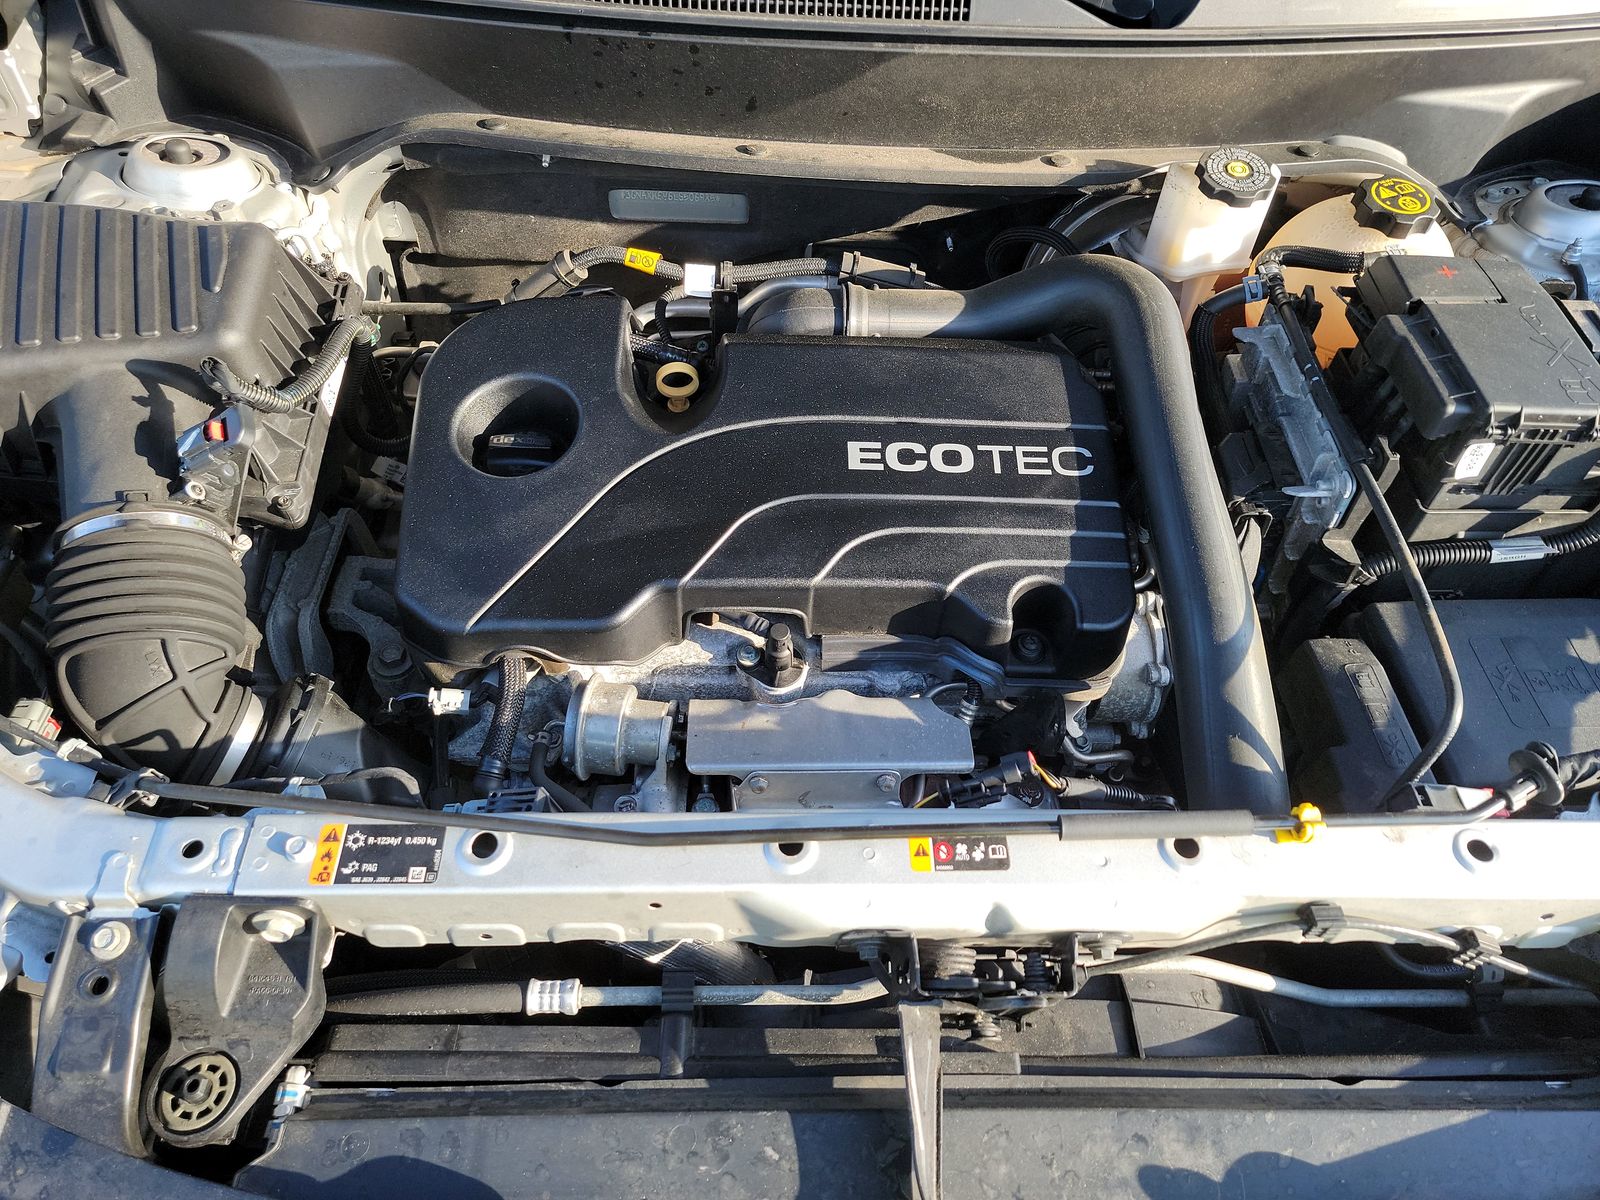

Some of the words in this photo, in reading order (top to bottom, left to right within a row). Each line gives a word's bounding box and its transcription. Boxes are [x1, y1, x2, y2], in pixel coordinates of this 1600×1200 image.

[847, 441, 1094, 477] ECOTEC
[367, 836, 402, 847] R-1234yf
[405, 836, 427, 845] 0.450
[427, 836, 437, 847] kg
[955, 853, 970, 861] AUTO
[361, 863, 378, 873] PAG
